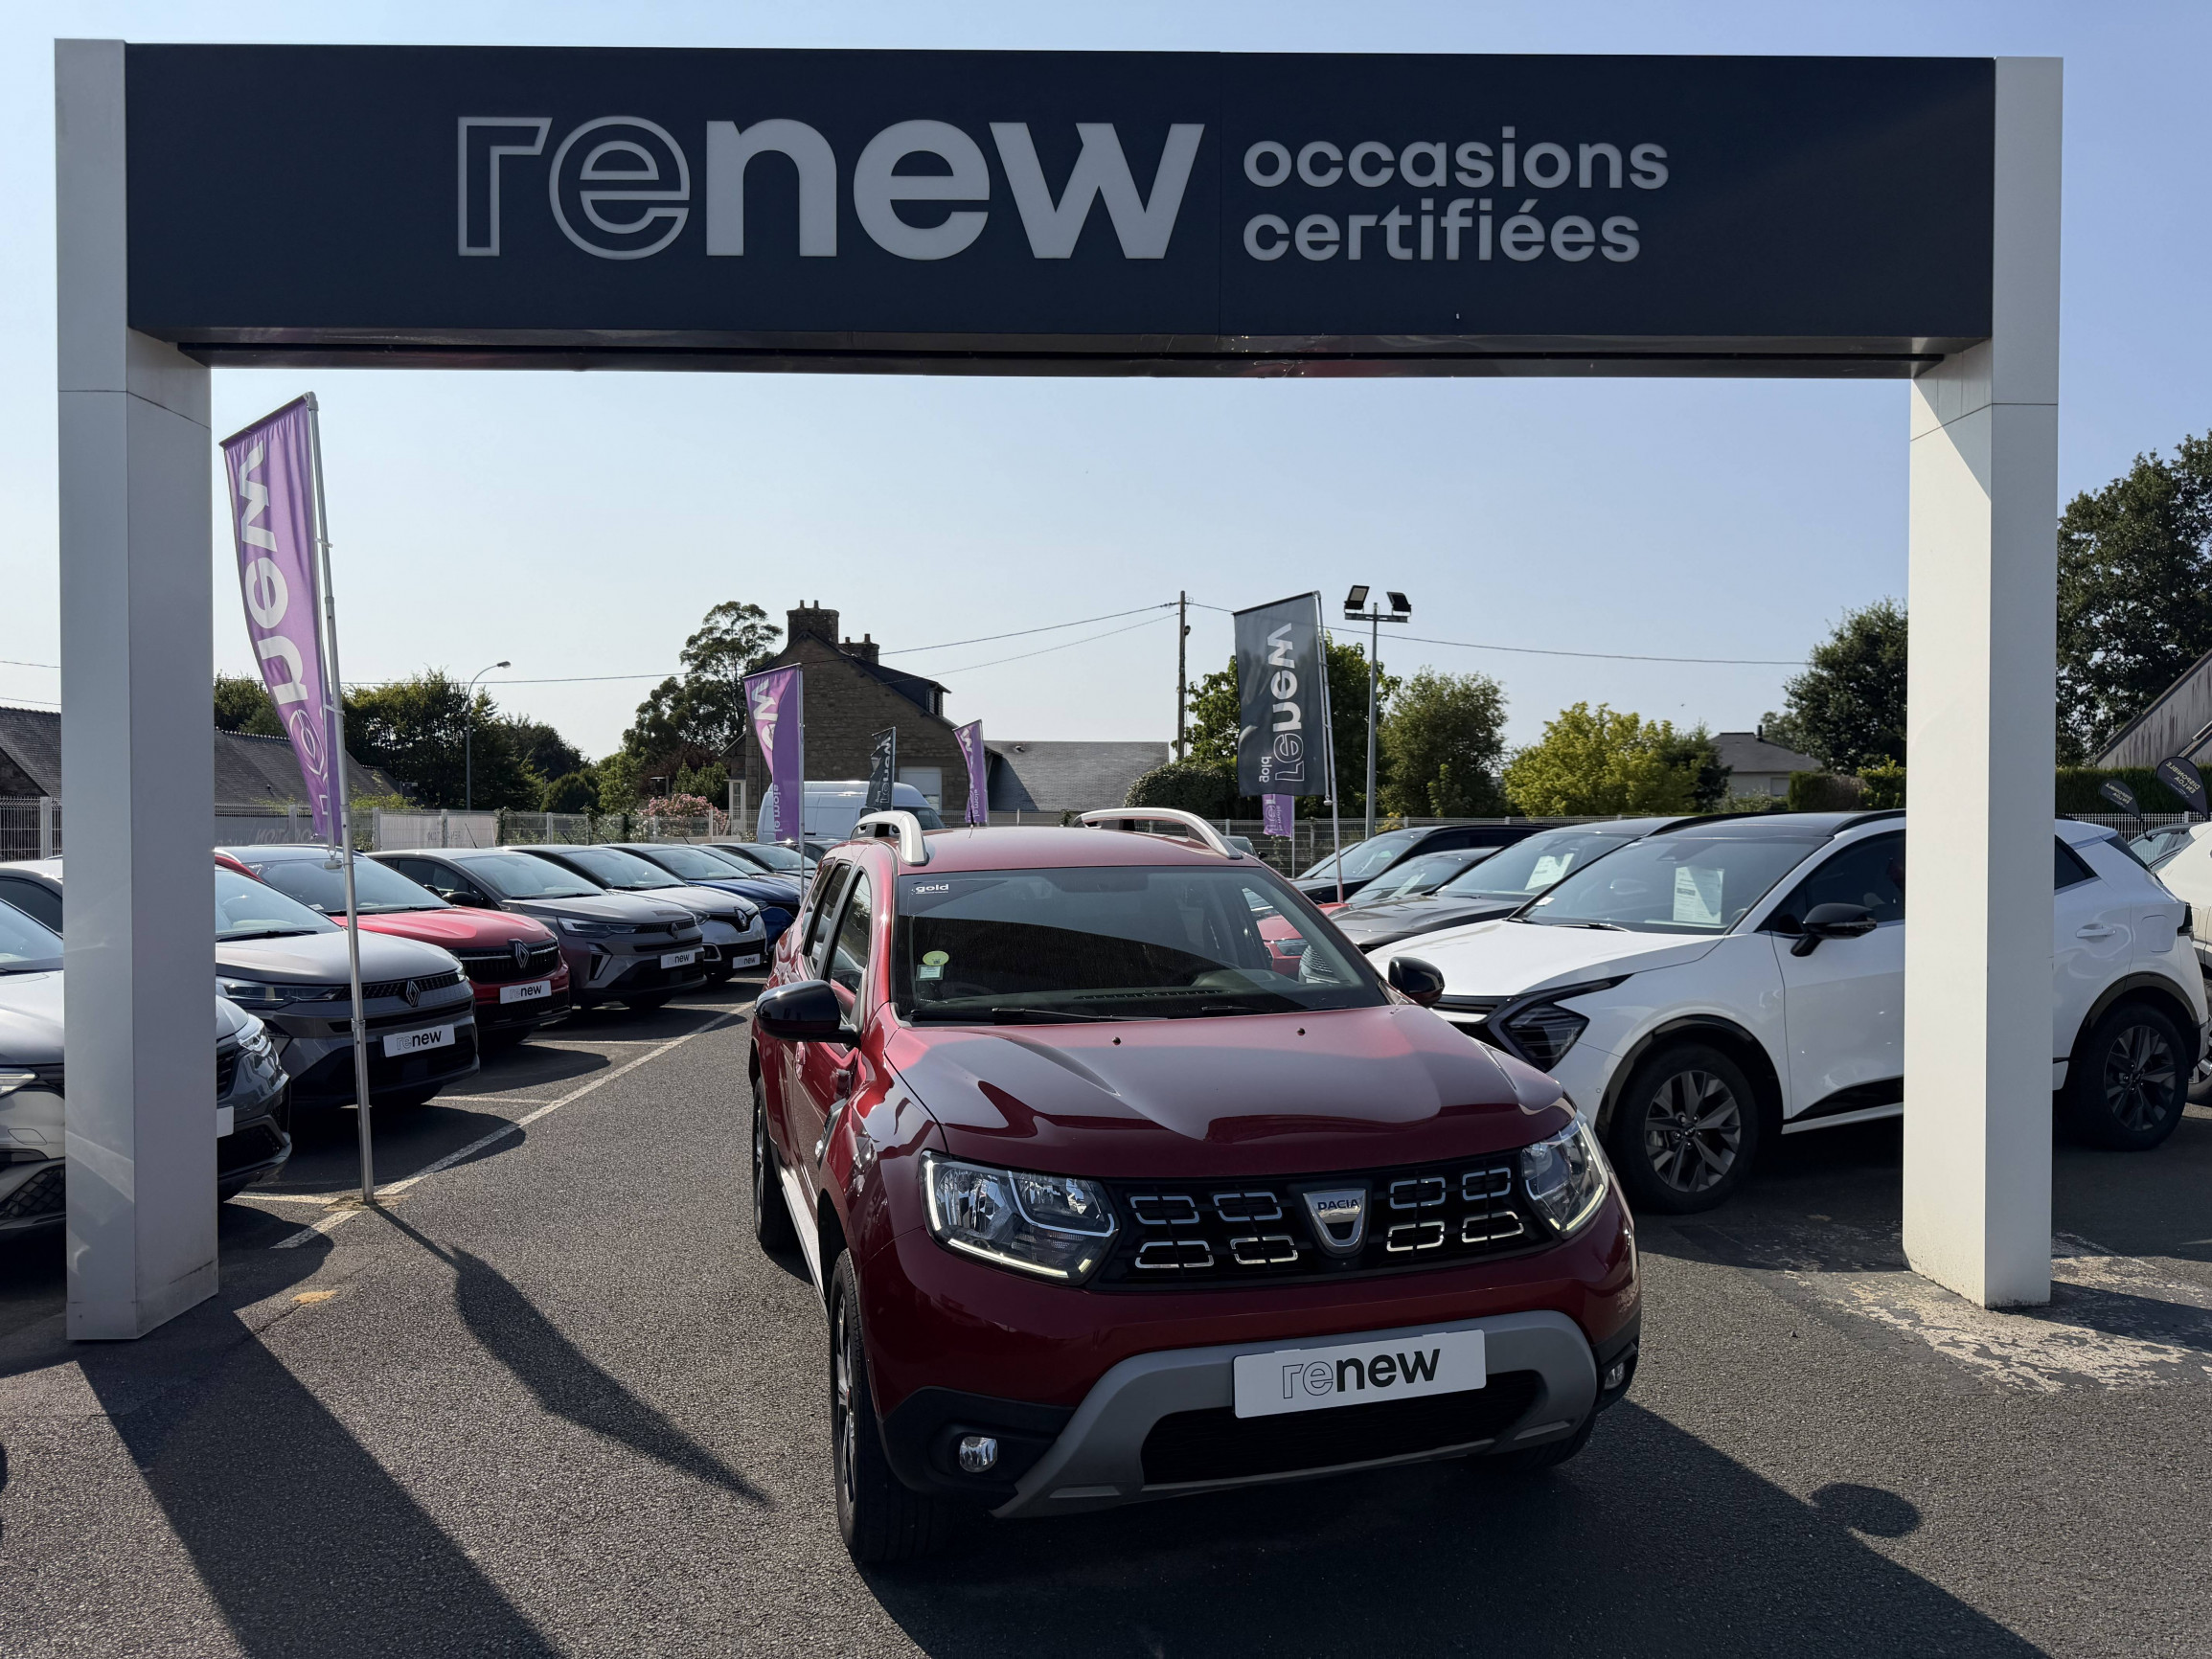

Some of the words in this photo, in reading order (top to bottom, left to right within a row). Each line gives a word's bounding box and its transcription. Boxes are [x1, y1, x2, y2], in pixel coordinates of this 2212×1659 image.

[1243, 125, 1669, 190] occasions
[457, 115, 1205, 261] renew
[1243, 197, 1640, 262] certifiées
[915, 883, 949, 893] gold
[509, 984, 543, 1000] renew
[396, 1030, 443, 1051] renew
[1317, 1198, 1360, 1211] DACIA
[1282, 1348, 1441, 1399] renew
